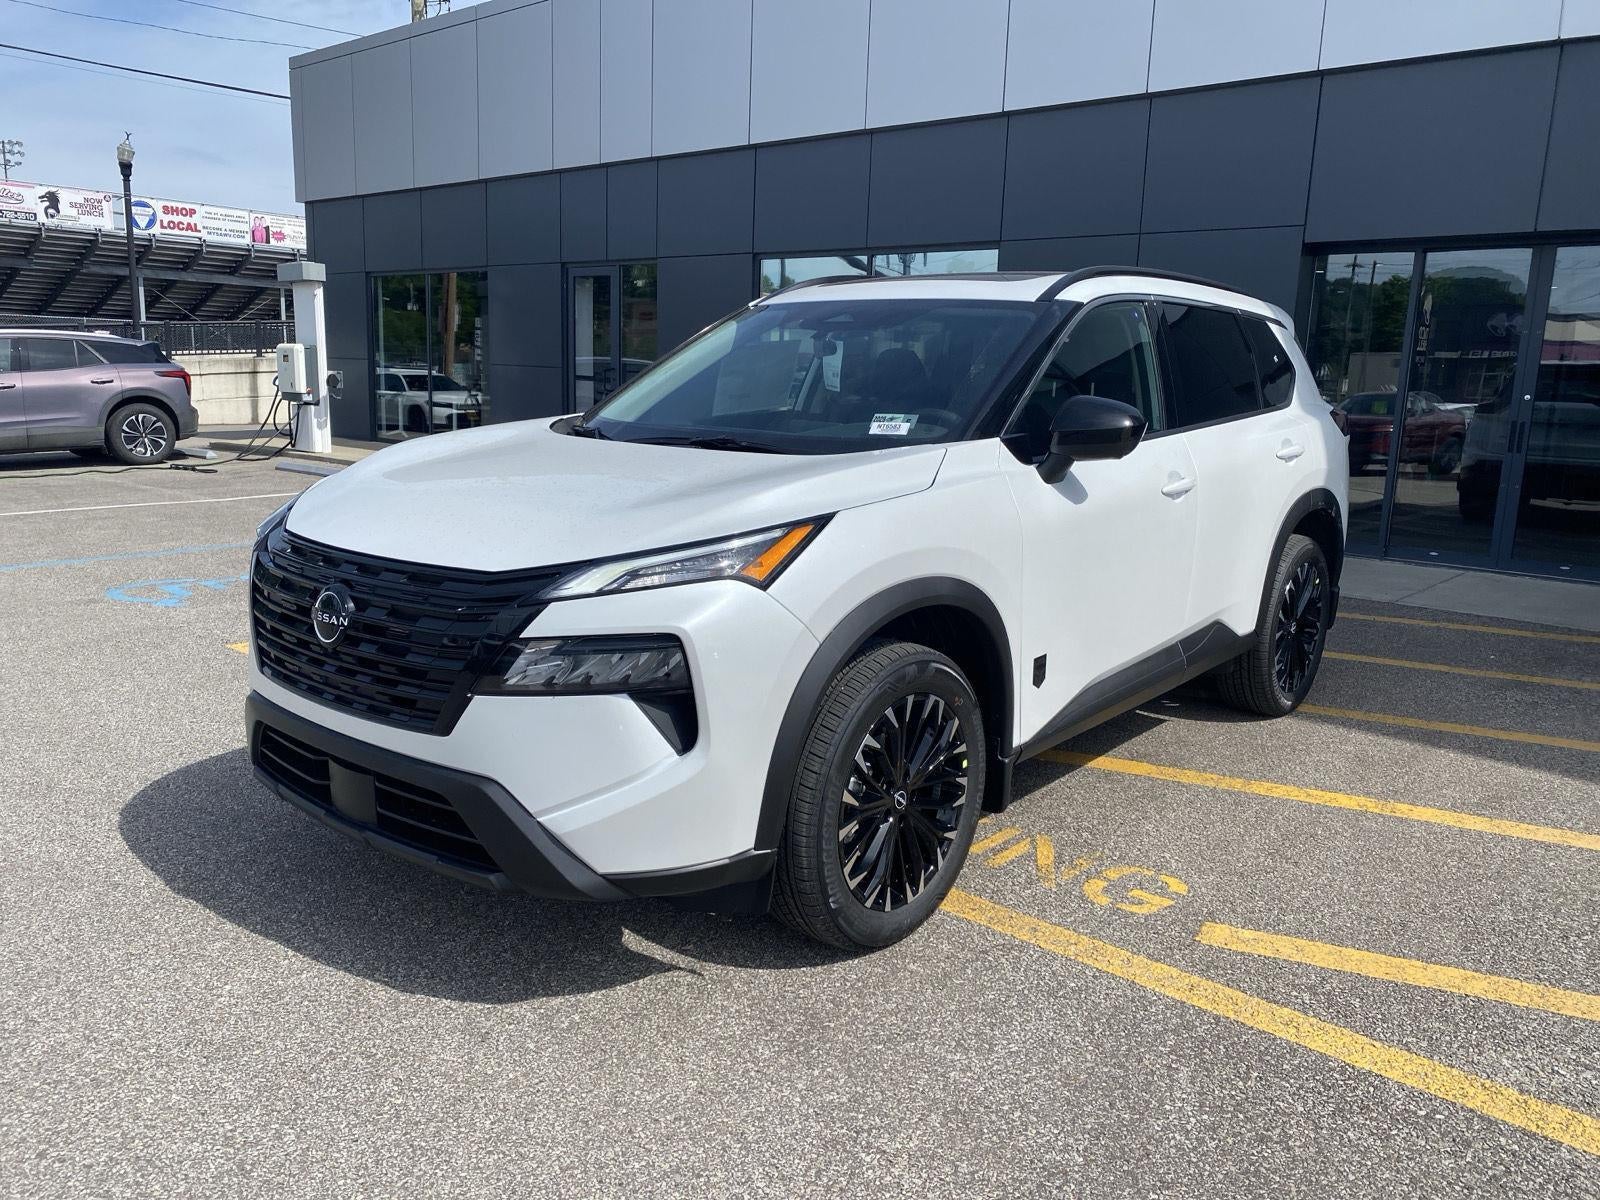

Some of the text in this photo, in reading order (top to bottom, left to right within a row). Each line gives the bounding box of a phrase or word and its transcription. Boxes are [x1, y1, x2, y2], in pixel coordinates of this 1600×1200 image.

[83, 196, 103, 204] NOW
[69, 201, 104, 211] SERVING
[162, 205, 197, 218] SHOP
[77, 208, 104, 218] LUNCH
[159, 219, 202, 233] LOCAL
[312, 607, 349, 627] SSAN
